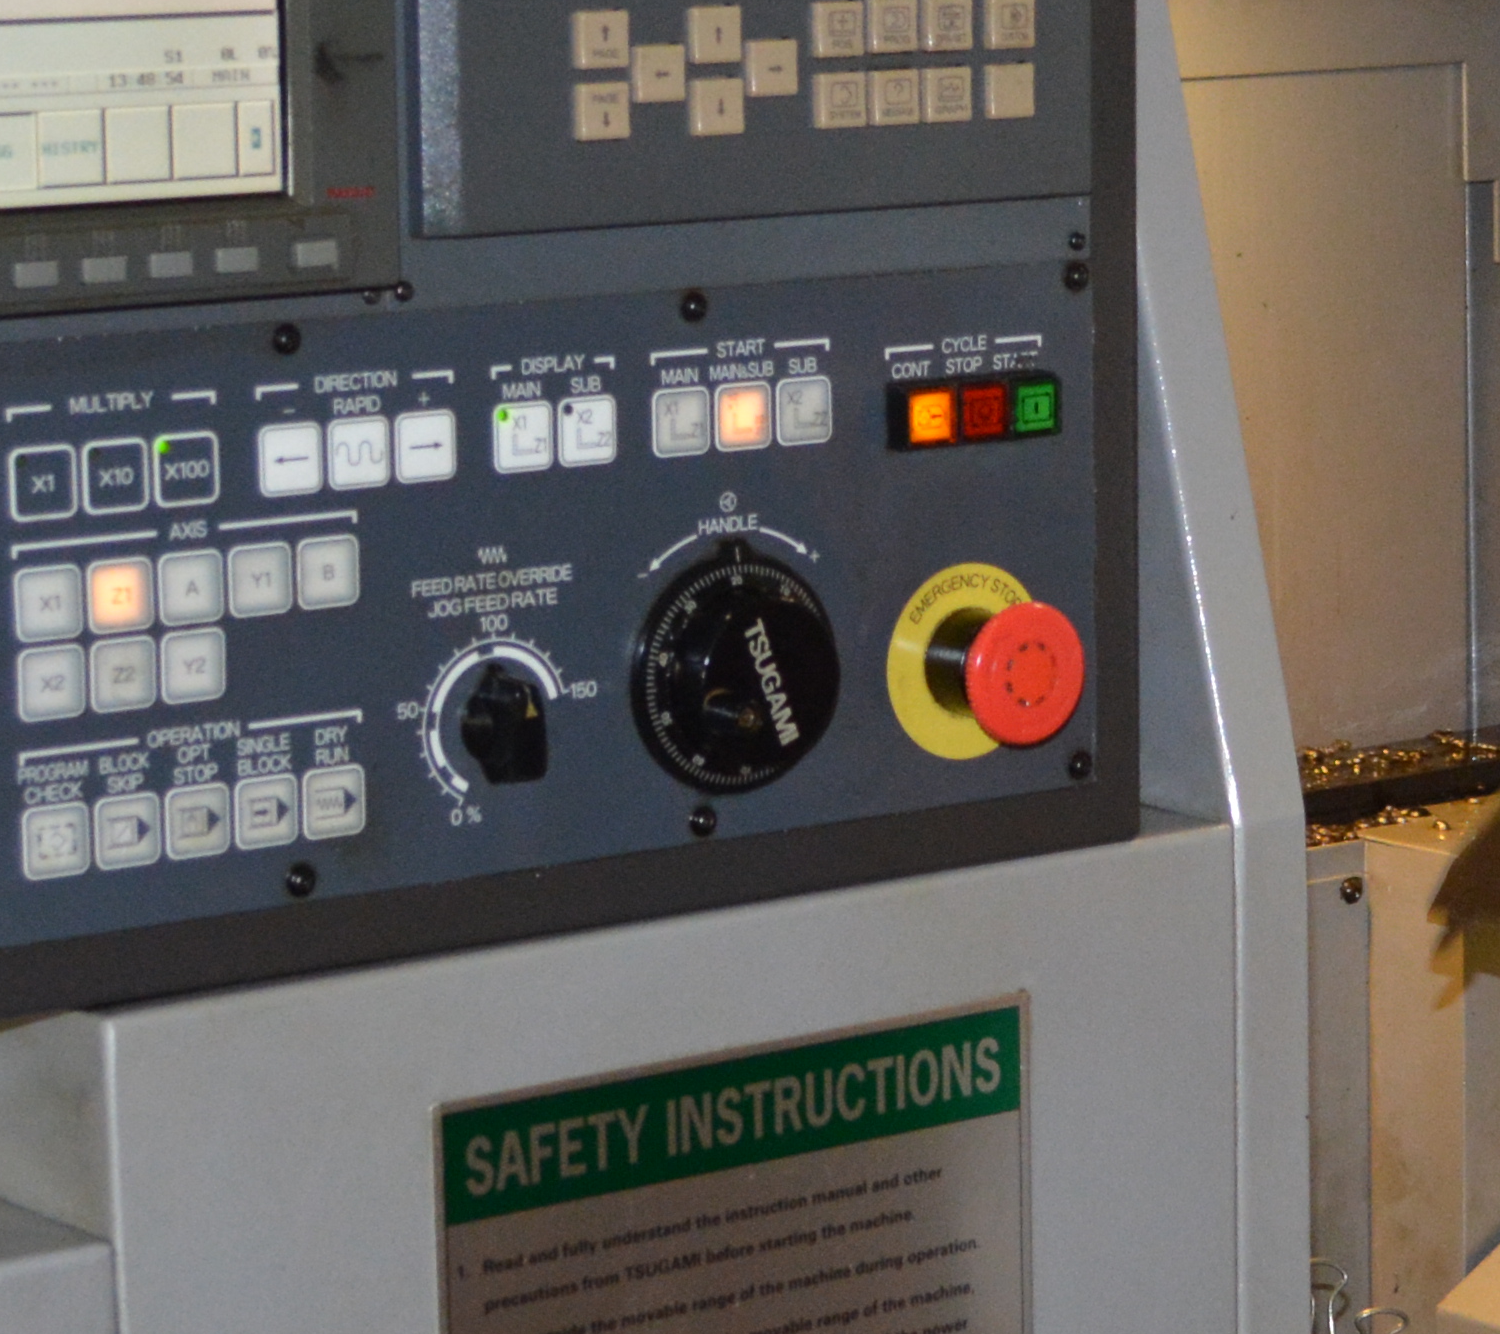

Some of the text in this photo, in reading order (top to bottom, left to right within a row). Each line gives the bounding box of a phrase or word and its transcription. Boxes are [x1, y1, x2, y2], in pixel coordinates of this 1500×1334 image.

[716, 338, 766, 358] START
[942, 335, 987, 353] CYCLE
[521, 354, 585, 376] DISPLAY
[788, 357, 817, 375] SUB
[892, 360, 930, 379] CONT
[946, 356, 982, 374] STOP
[315, 371, 397, 394] DIRECTION
[570, 375, 601, 394] SUB
[661, 367, 699, 385] MAIN
[503, 380, 541, 399] MAIN
[69, 392, 153, 415] MULTIPLY
[333, 395, 381, 415] RAPID
[100, 467, 133, 487] X10
[164, 460, 209, 480] X100
[32, 474, 55, 494] X1
[169, 520, 207, 541] AXIS
[698, 514, 759, 536] HANDLE
[500, 563, 573, 588] OVERRIDE
[428, 597, 462, 618] JOG
[909, 573, 991, 624] EMERGENCY
[480, 614, 508, 633] 100
[570, 681, 598, 699] 150
[744, 617, 800, 747] TSUGAMI
[396, 702, 418, 721] 50
[147, 721, 241, 748] OPERATION
[315, 726, 347, 746] DRY
[177, 744, 210, 764] OPT
[236, 733, 291, 757] SINGLE
[99, 753, 150, 775] BLOCK
[238, 754, 292, 777] BLOCK
[315, 747, 349, 766] RUN
[17, 759, 88, 785] PROGRAM
[173, 764, 219, 785] STOP
[24, 781, 83, 805] CHECK
[107, 773, 144, 794] SKIP
[465, 1035, 1001, 1198] SAFETY INSTRUCTIONS
